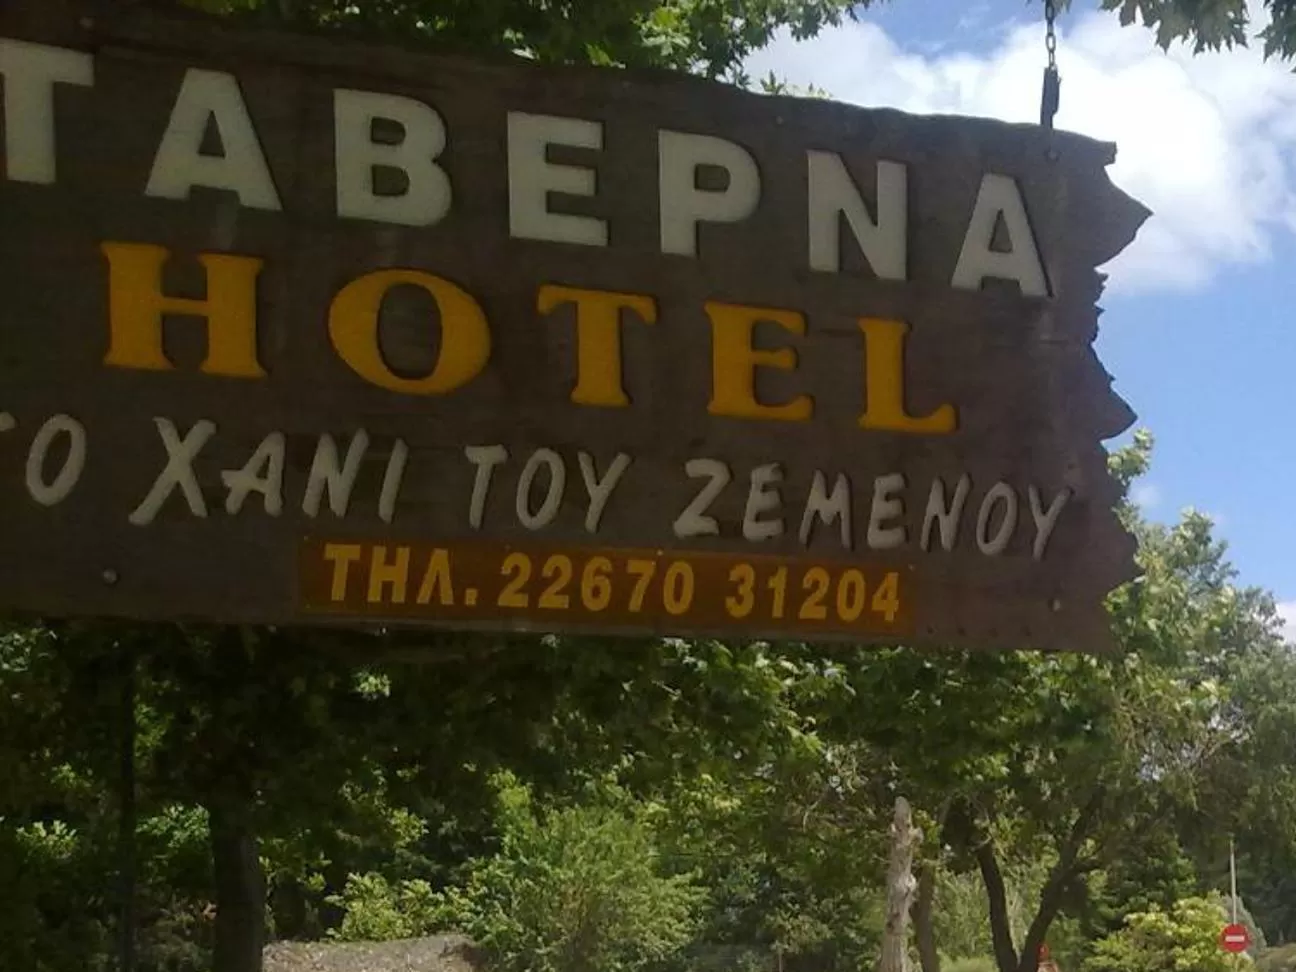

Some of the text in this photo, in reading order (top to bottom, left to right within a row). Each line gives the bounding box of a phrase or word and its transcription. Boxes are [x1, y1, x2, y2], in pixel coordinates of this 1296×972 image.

[0, 38, 1054, 298] ΤΑΒΕΡΝΑ
[100, 240, 959, 434] HOTEL
[0, 411, 1073, 561] Ο ΧΑΝΙ ΤΟΥ ΖΕΜΕΝΟΥ
[323, 542, 900, 622] ΤΗΛ. 22670 31204
